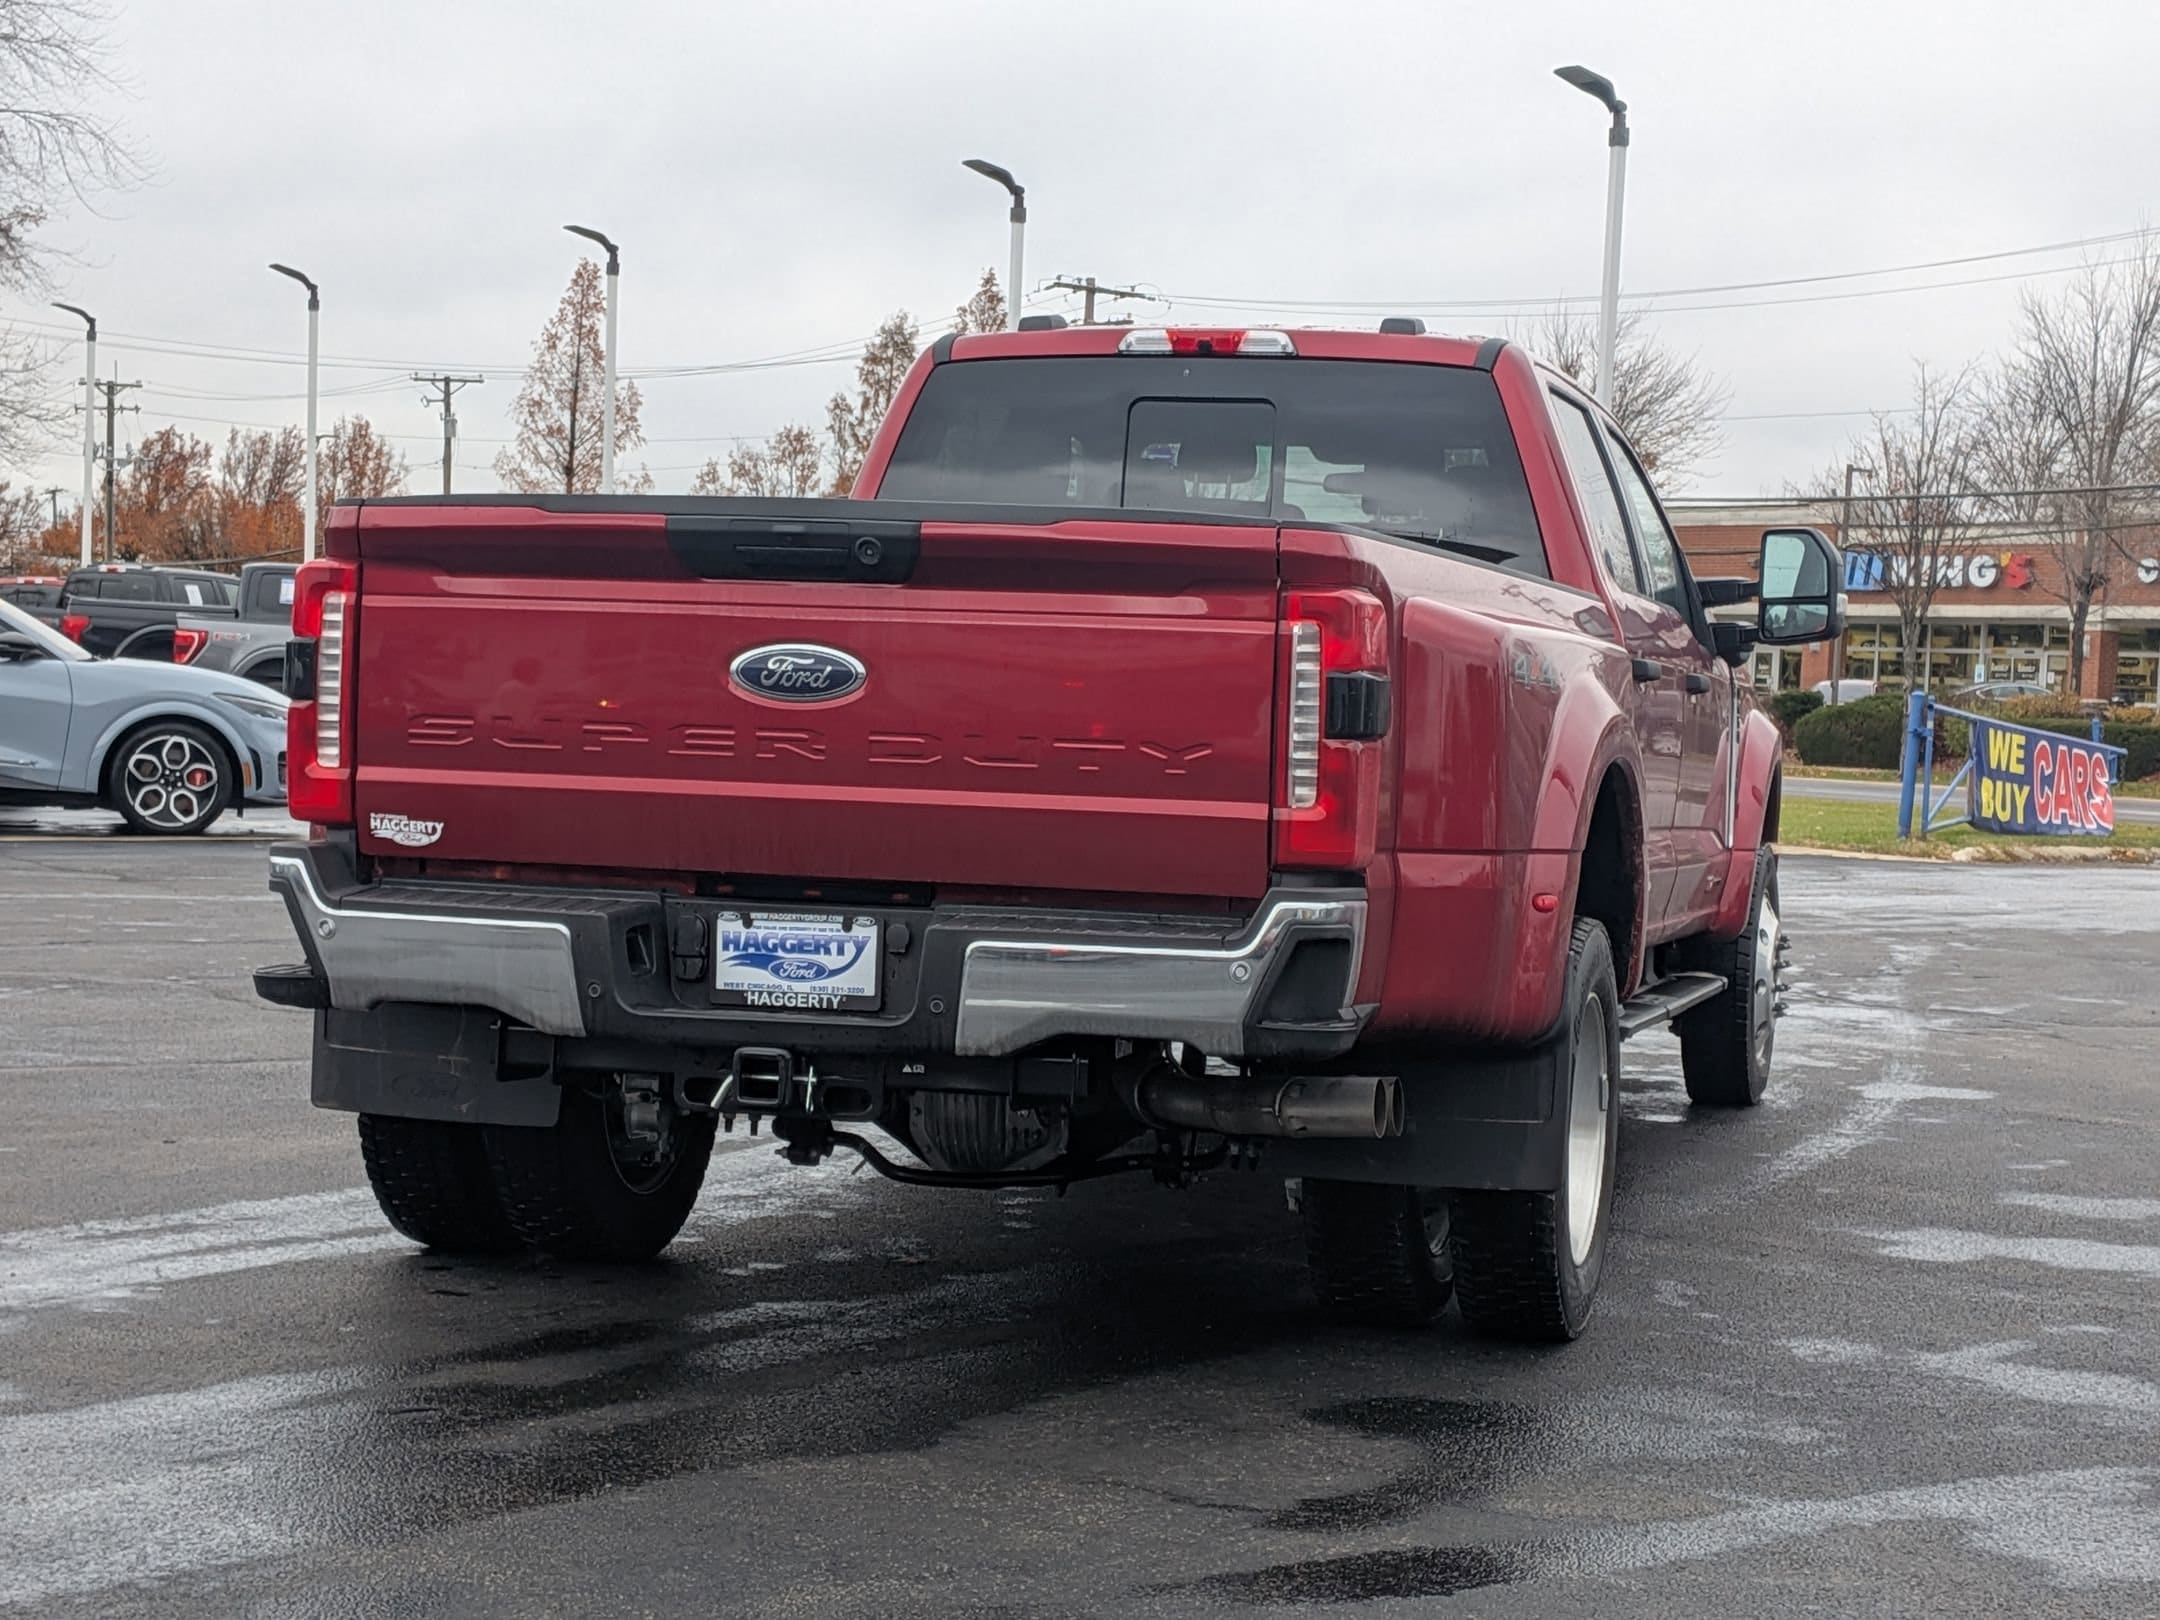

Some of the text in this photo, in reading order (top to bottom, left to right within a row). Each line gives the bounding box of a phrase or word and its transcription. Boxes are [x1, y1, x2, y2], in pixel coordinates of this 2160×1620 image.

[760, 656, 832, 688] Ford
[407, 713, 1213, 774] SUPER DUTY
[1988, 727, 2026, 775] WE
[1981, 776, 2031, 825] BUY
[2033, 740, 2113, 830] CARS
[370, 818, 444, 834] HAGGERTY
[722, 931, 871, 957] HAGGERTY
[778, 960, 816, 979] Ford
[746, 991, 842, 1010] HAGGERTY
